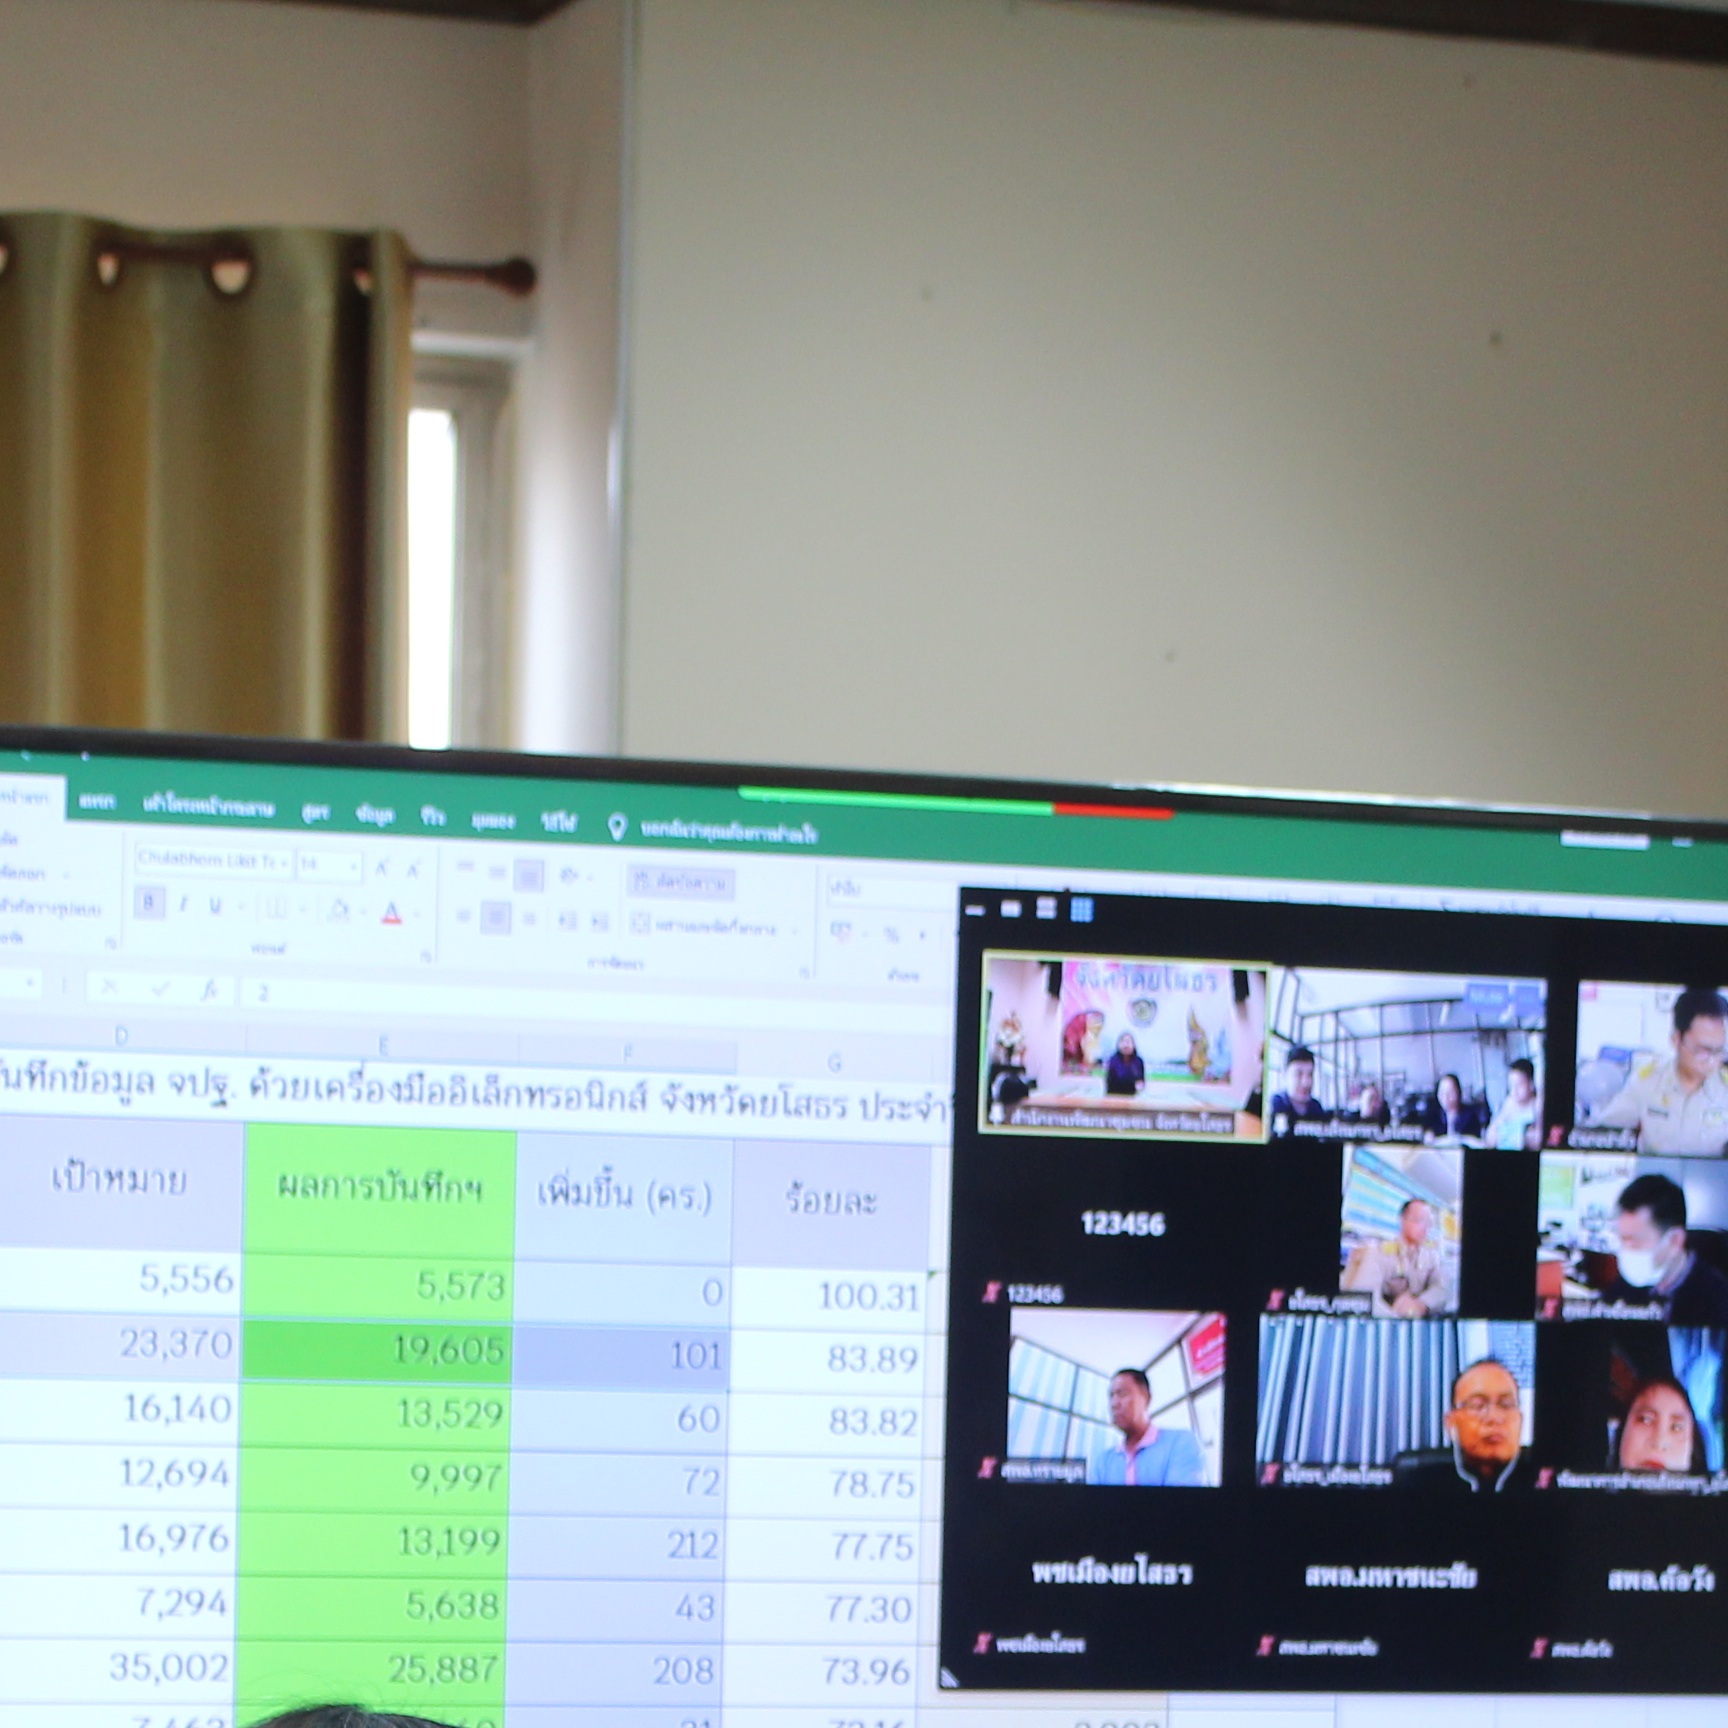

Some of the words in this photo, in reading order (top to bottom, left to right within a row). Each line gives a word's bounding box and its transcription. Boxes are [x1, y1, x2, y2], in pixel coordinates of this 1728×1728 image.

[658, 1083, 849, 1122] จังหวัดยโสธร
[50, 1157, 189, 1196] เป้าหมาย
[276, 1169, 484, 1204] ผลการบันทึกฯ
[536, 1163, 635, 1209] เพิ่มขึ้น
[645, 1181, 713, 1216] (คร.)
[785, 1181, 879, 1217] ร้อยละ
[1082, 1211, 1166, 1237] 123456
[141, 1264, 234, 1296] 5,556
[418, 1270, 505, 1302] 5,573
[703, 1278, 724, 1306] 0
[1007, 1284, 1065, 1304] 123456
[821, 1281, 918, 1311] 100.31
[121, 1328, 232, 1361] 23,370
[397, 1334, 504, 1365] 19,605
[673, 1341, 720, 1369] 101
[828, 1346, 918, 1372] 83.89
[126, 1393, 232, 1425] 16,140
[400, 1398, 504, 1430] 13,529
[678, 1405, 720, 1432] 60
[829, 1408, 918, 1436] 83.82
[122, 1458, 229, 1490] 12,694
[411, 1464, 502, 1494] 9,997
[685, 1467, 720, 1496] 72
[834, 1470, 915, 1498] 78.75
[121, 1523, 229, 1555] 16,976
[401, 1526, 501, 1557] 13,199
[668, 1530, 718, 1559] 212
[835, 1532, 914, 1561] 77.75
[140, 1588, 227, 1620] 7,294
[407, 1591, 499, 1622] 5,638
[676, 1594, 715, 1621] 43
[830, 1595, 912, 1623] 77.30
[110, 1653, 228, 1685] 35,002
[390, 1655, 498, 1685] 25,887
[654, 1657, 714, 1685] 208
[826, 1657, 910, 1685] 73.96
